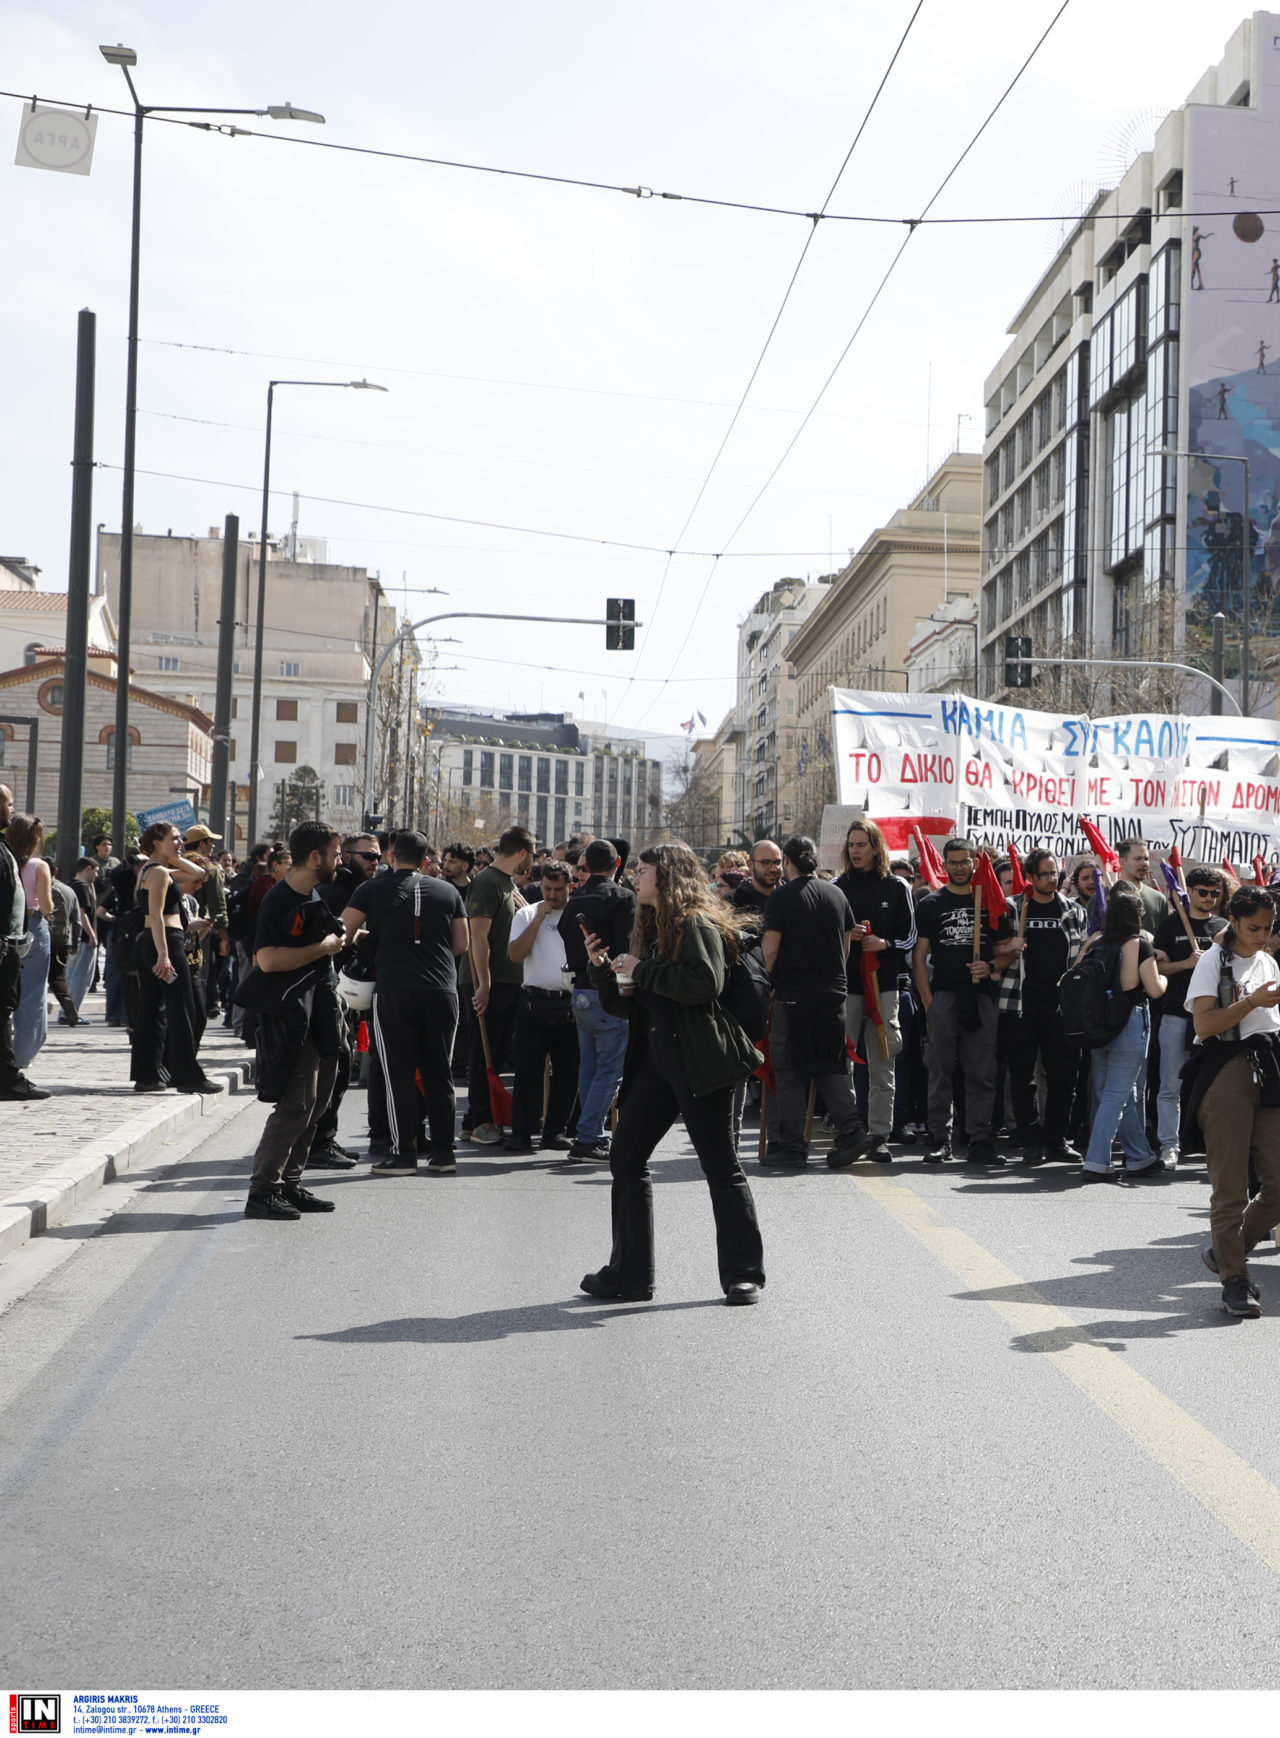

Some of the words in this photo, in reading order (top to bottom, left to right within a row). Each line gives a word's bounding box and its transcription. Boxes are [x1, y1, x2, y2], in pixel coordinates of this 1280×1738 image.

[941, 700, 1027, 750] ΚΑΜΙΑ
[849, 753, 882, 784] ΤΟ
[900, 753, 955, 784] ΔΙΚΙΟ
[965, 759, 993, 790] ΘΑ
[1011, 769, 1076, 808] ΚΡΙΘΕΙ
[1088, 777, 1112, 807] ΜΕ
[1130, 778, 1167, 808] ΤΟΝ
[1181, 780, 1221, 809] ΣΤΟΝ
